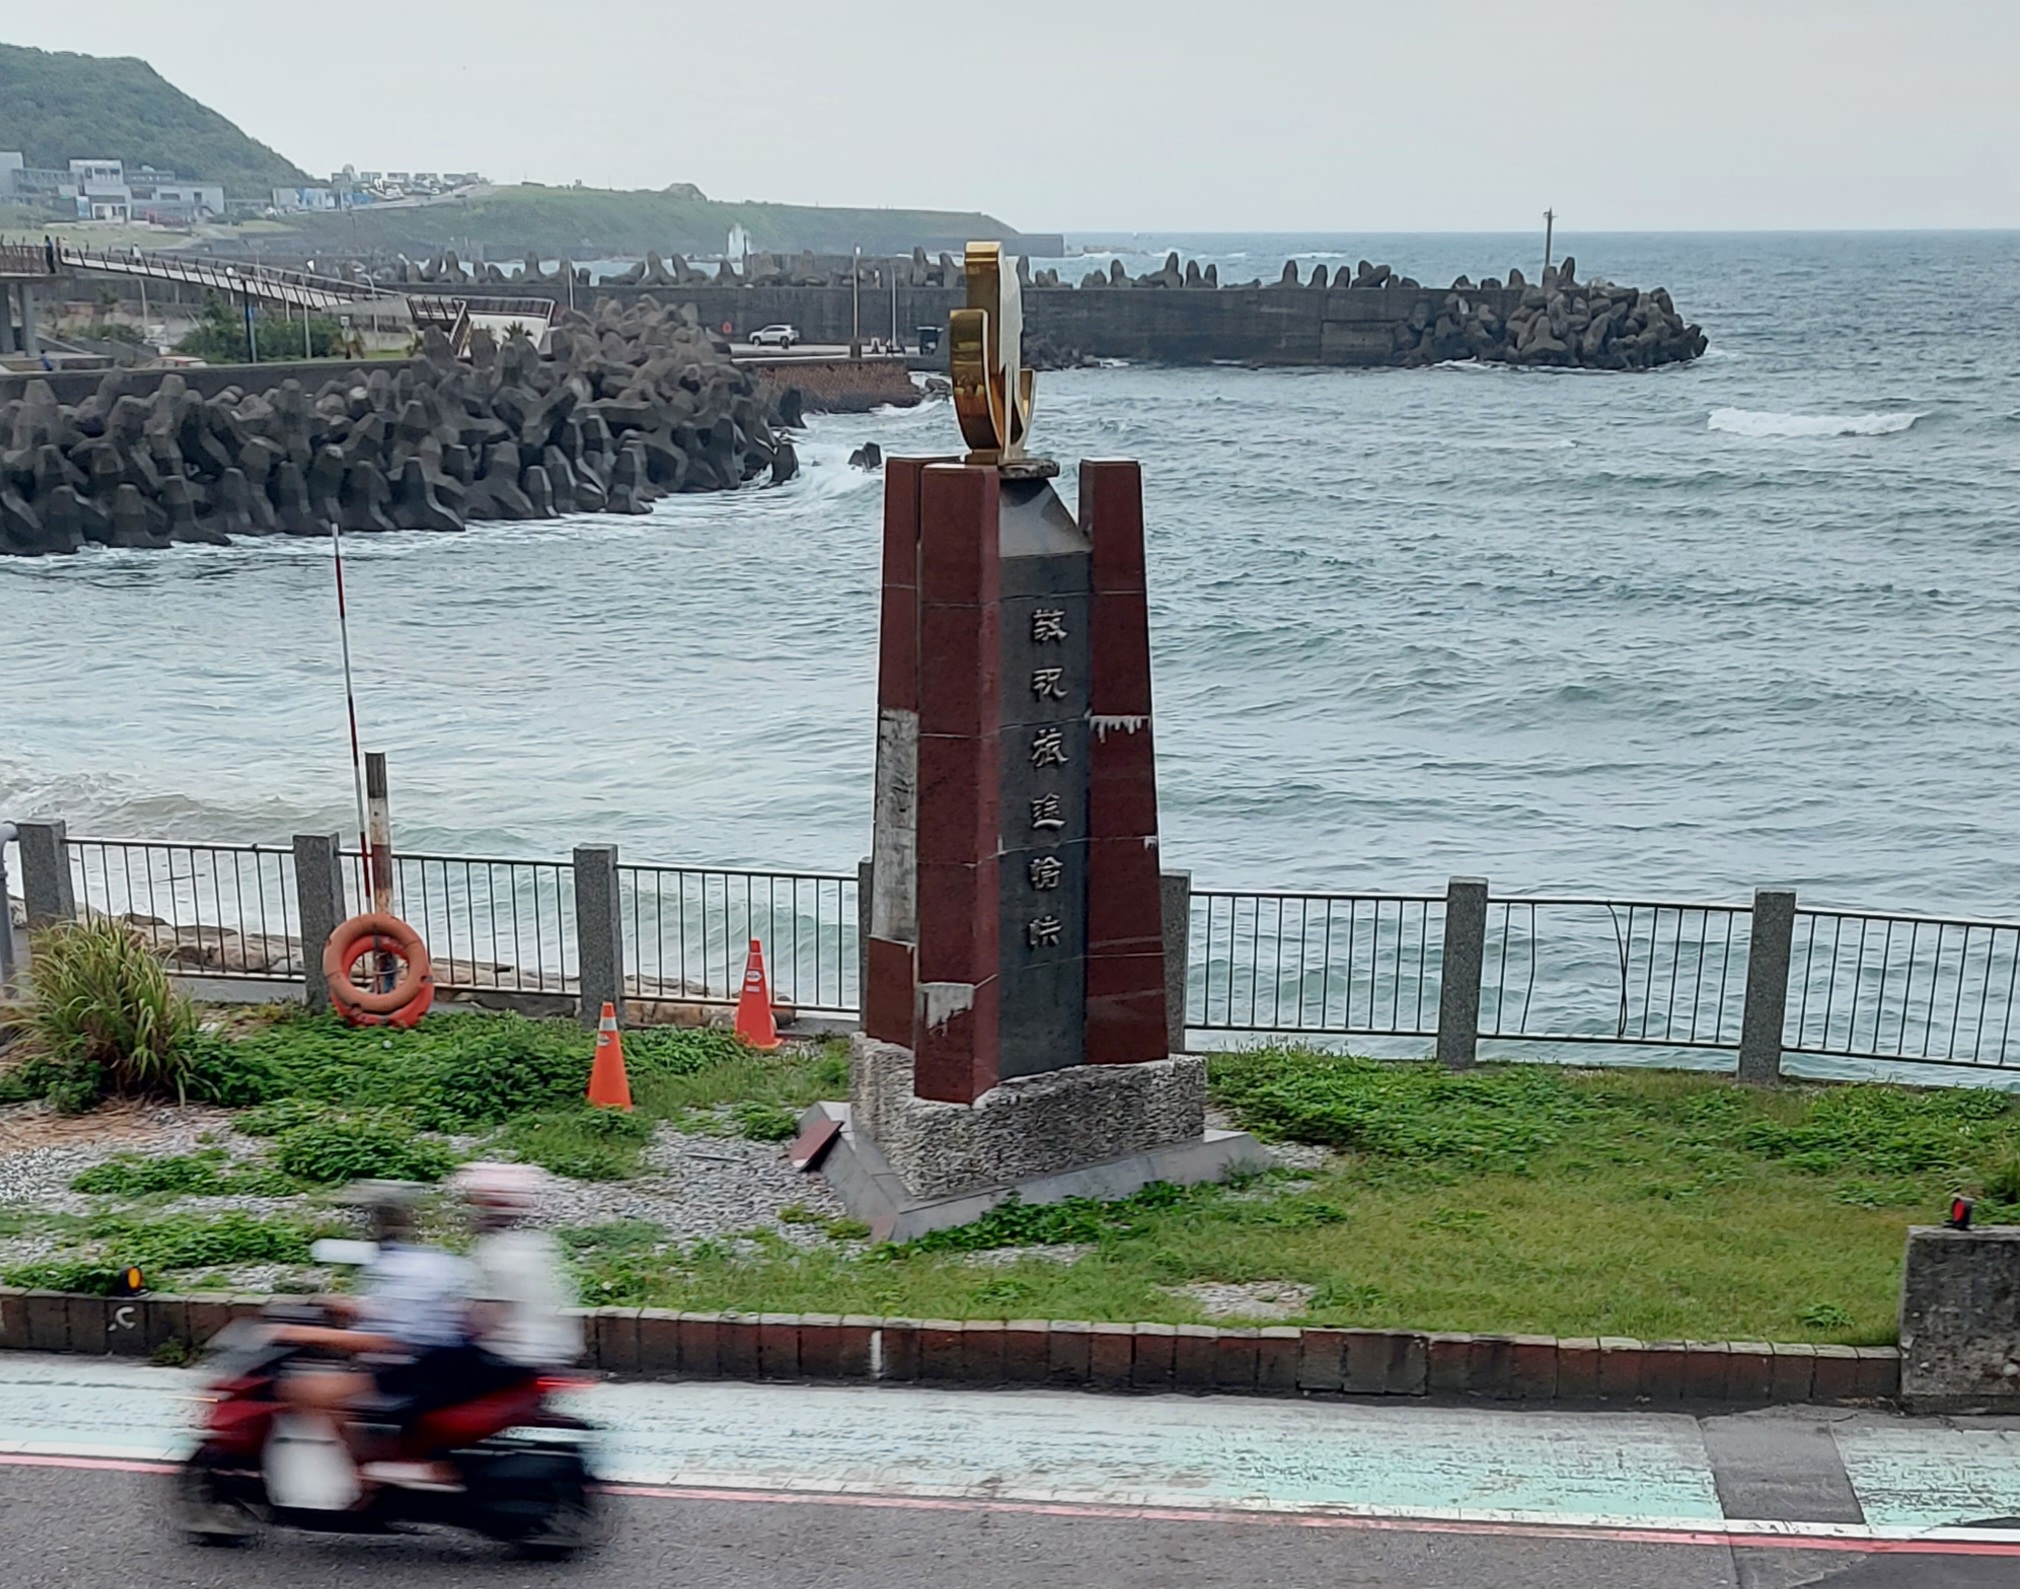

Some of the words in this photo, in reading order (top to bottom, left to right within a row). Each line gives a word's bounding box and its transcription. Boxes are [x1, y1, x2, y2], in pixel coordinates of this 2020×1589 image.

[1029, 608, 1069, 946] 敬祝旅途愉快
